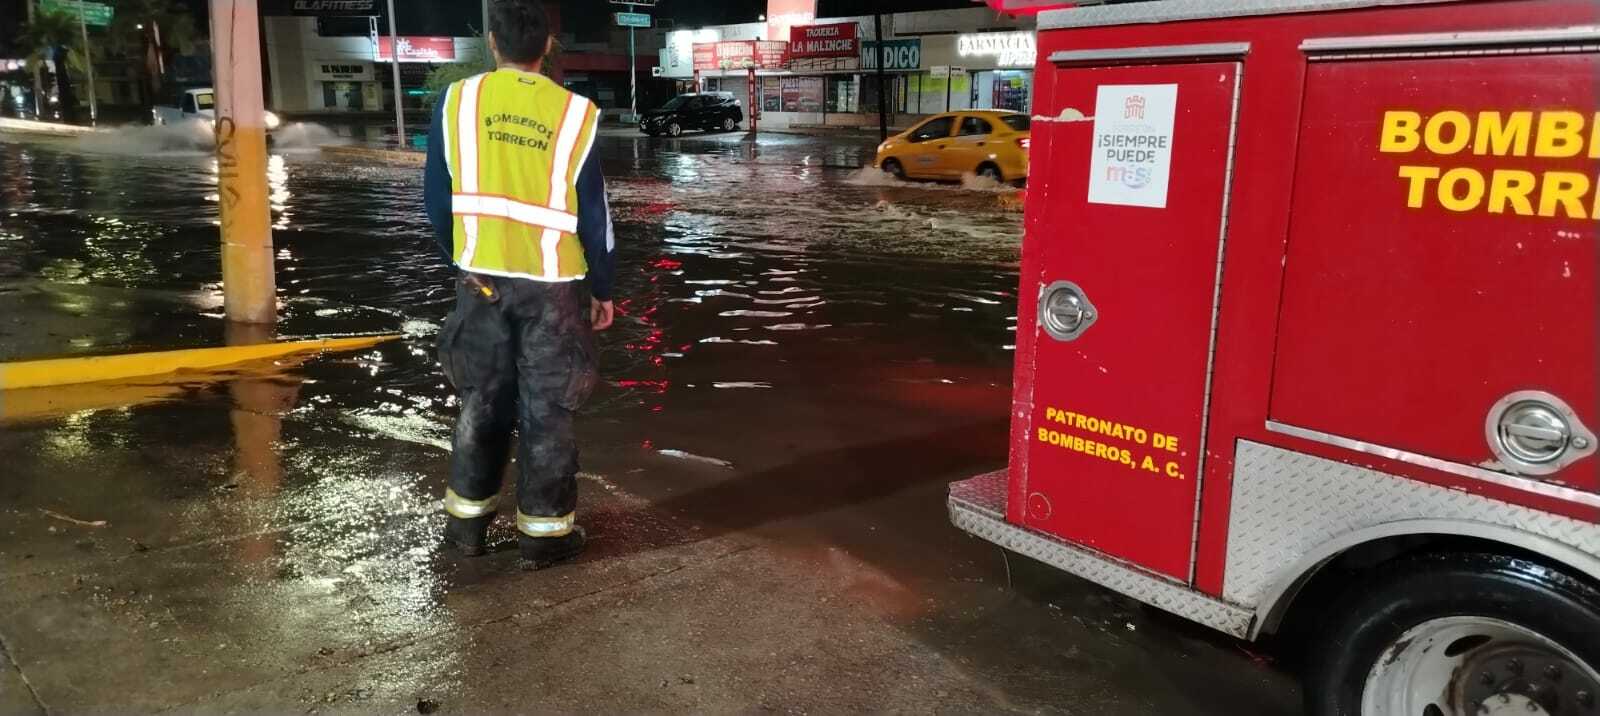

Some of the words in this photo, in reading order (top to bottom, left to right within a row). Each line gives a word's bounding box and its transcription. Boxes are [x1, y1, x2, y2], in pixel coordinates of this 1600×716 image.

[806, 26, 839, 37] TAQUERIA
[792, 41, 804, 53] LA
[806, 39, 853, 52] MALINCHE
[958, 34, 1034, 50] FARMACIA
[862, 46, 920, 68] MDICO
[485, 113, 553, 140] BOMBEROS
[488, 131, 548, 151] TORREON
[1098, 134, 1167, 148] ¡SIEMPRE
[1106, 149, 1156, 163] PUEDE
[1398, 166, 1600, 220] TORR
[1046, 407, 1147, 444] PATRONATO
[1152, 432, 1179, 452] DE
[1038, 427, 1136, 469] BOMBEROS,
[1141, 455, 1160, 473] A.
[1165, 462, 1185, 480] C.
